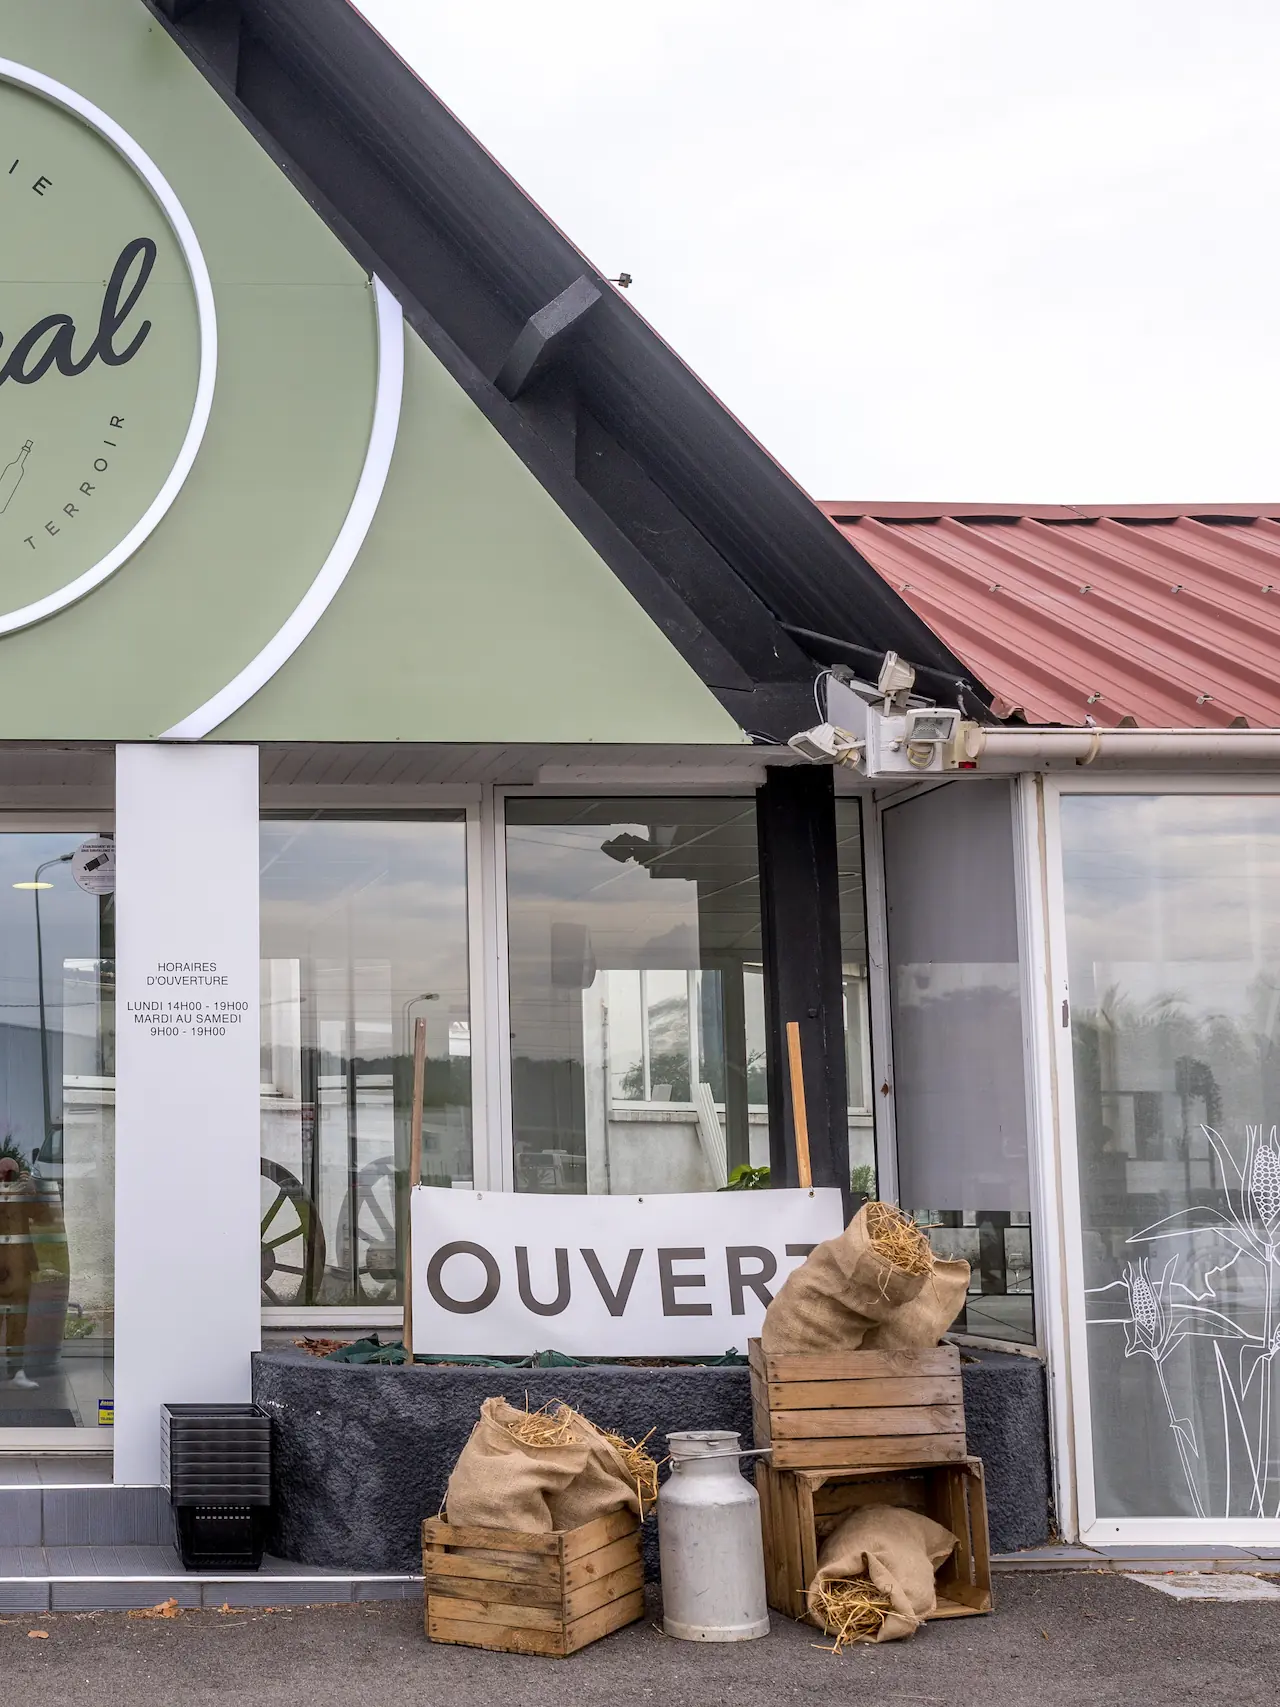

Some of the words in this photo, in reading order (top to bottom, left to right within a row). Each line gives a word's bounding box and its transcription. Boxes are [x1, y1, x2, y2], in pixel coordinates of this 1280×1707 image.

[24, 414, 125, 551] TERROIR
[157, 962, 217, 972] HORAIRES
[146, 976, 228, 985] D'OUVERTURE
[127, 1001, 163, 1010] LUNDI
[168, 1001, 202, 1010] 14H00
[214, 1001, 249, 1010] 19H00
[134, 1014, 173, 1023] MARDI
[176, 1014, 192, 1023] AU
[196, 1014, 241, 1023] SAMEDI
[150, 1027, 179, 1036] 9H00
[191, 1027, 226, 1036] 19H00
